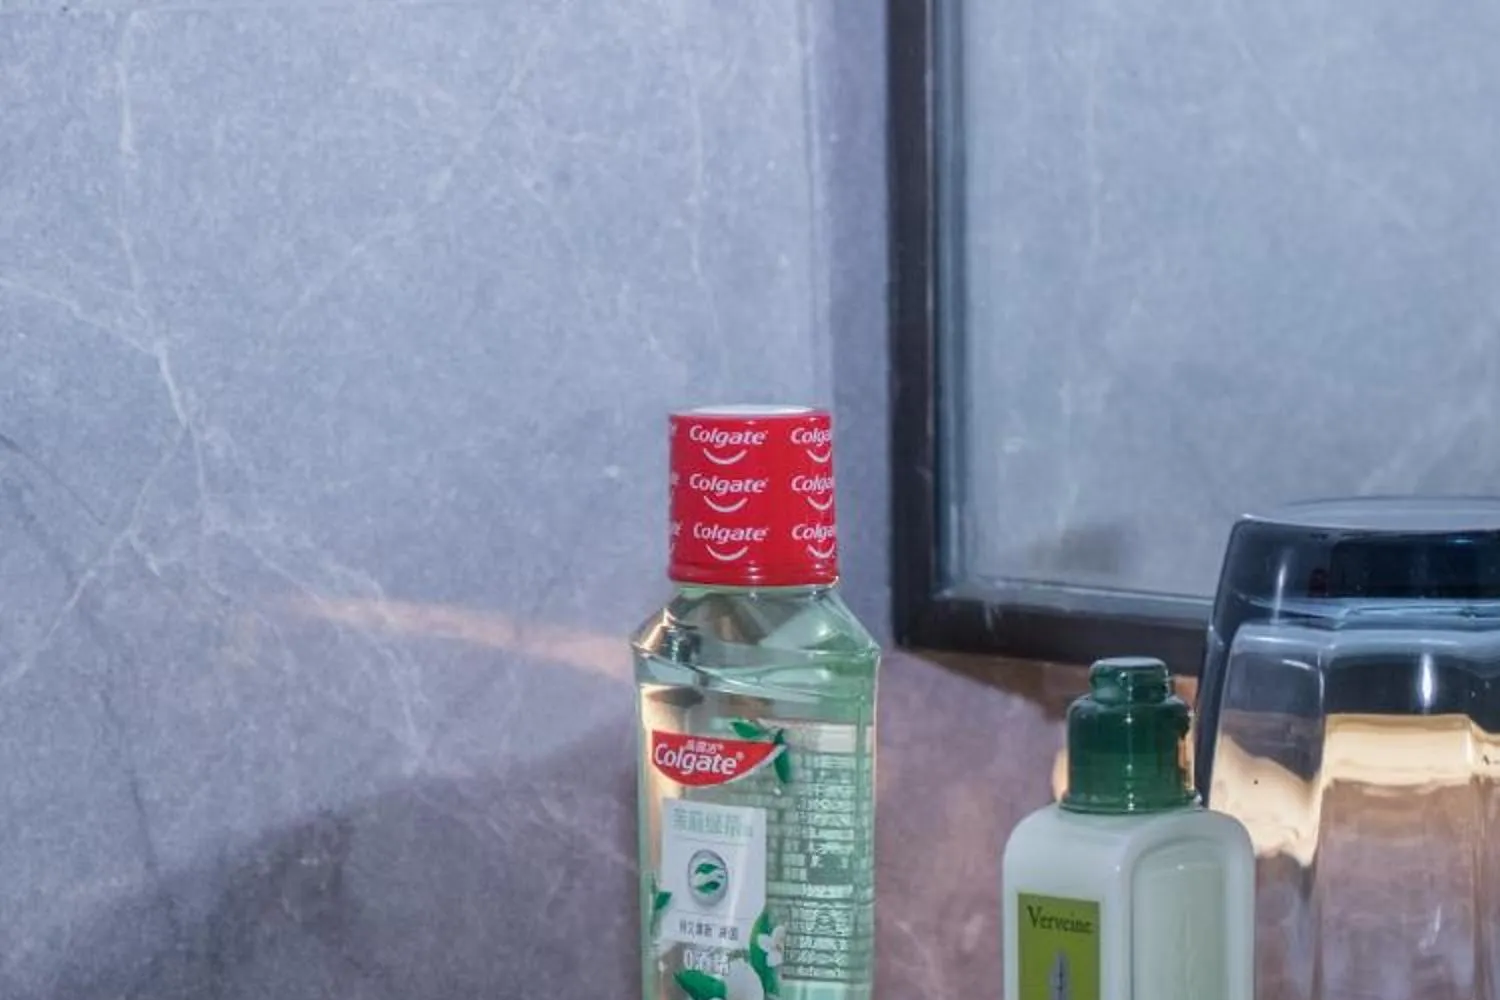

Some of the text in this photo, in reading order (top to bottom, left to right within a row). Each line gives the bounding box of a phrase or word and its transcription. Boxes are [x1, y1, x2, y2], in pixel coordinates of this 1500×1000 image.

[690, 424, 768, 446] Colgate
[690, 472, 768, 496] Colgate
[692, 521, 769, 544] Colgate
[655, 743, 738, 775] Colgate
[1027, 905, 1094, 935] Verveine
